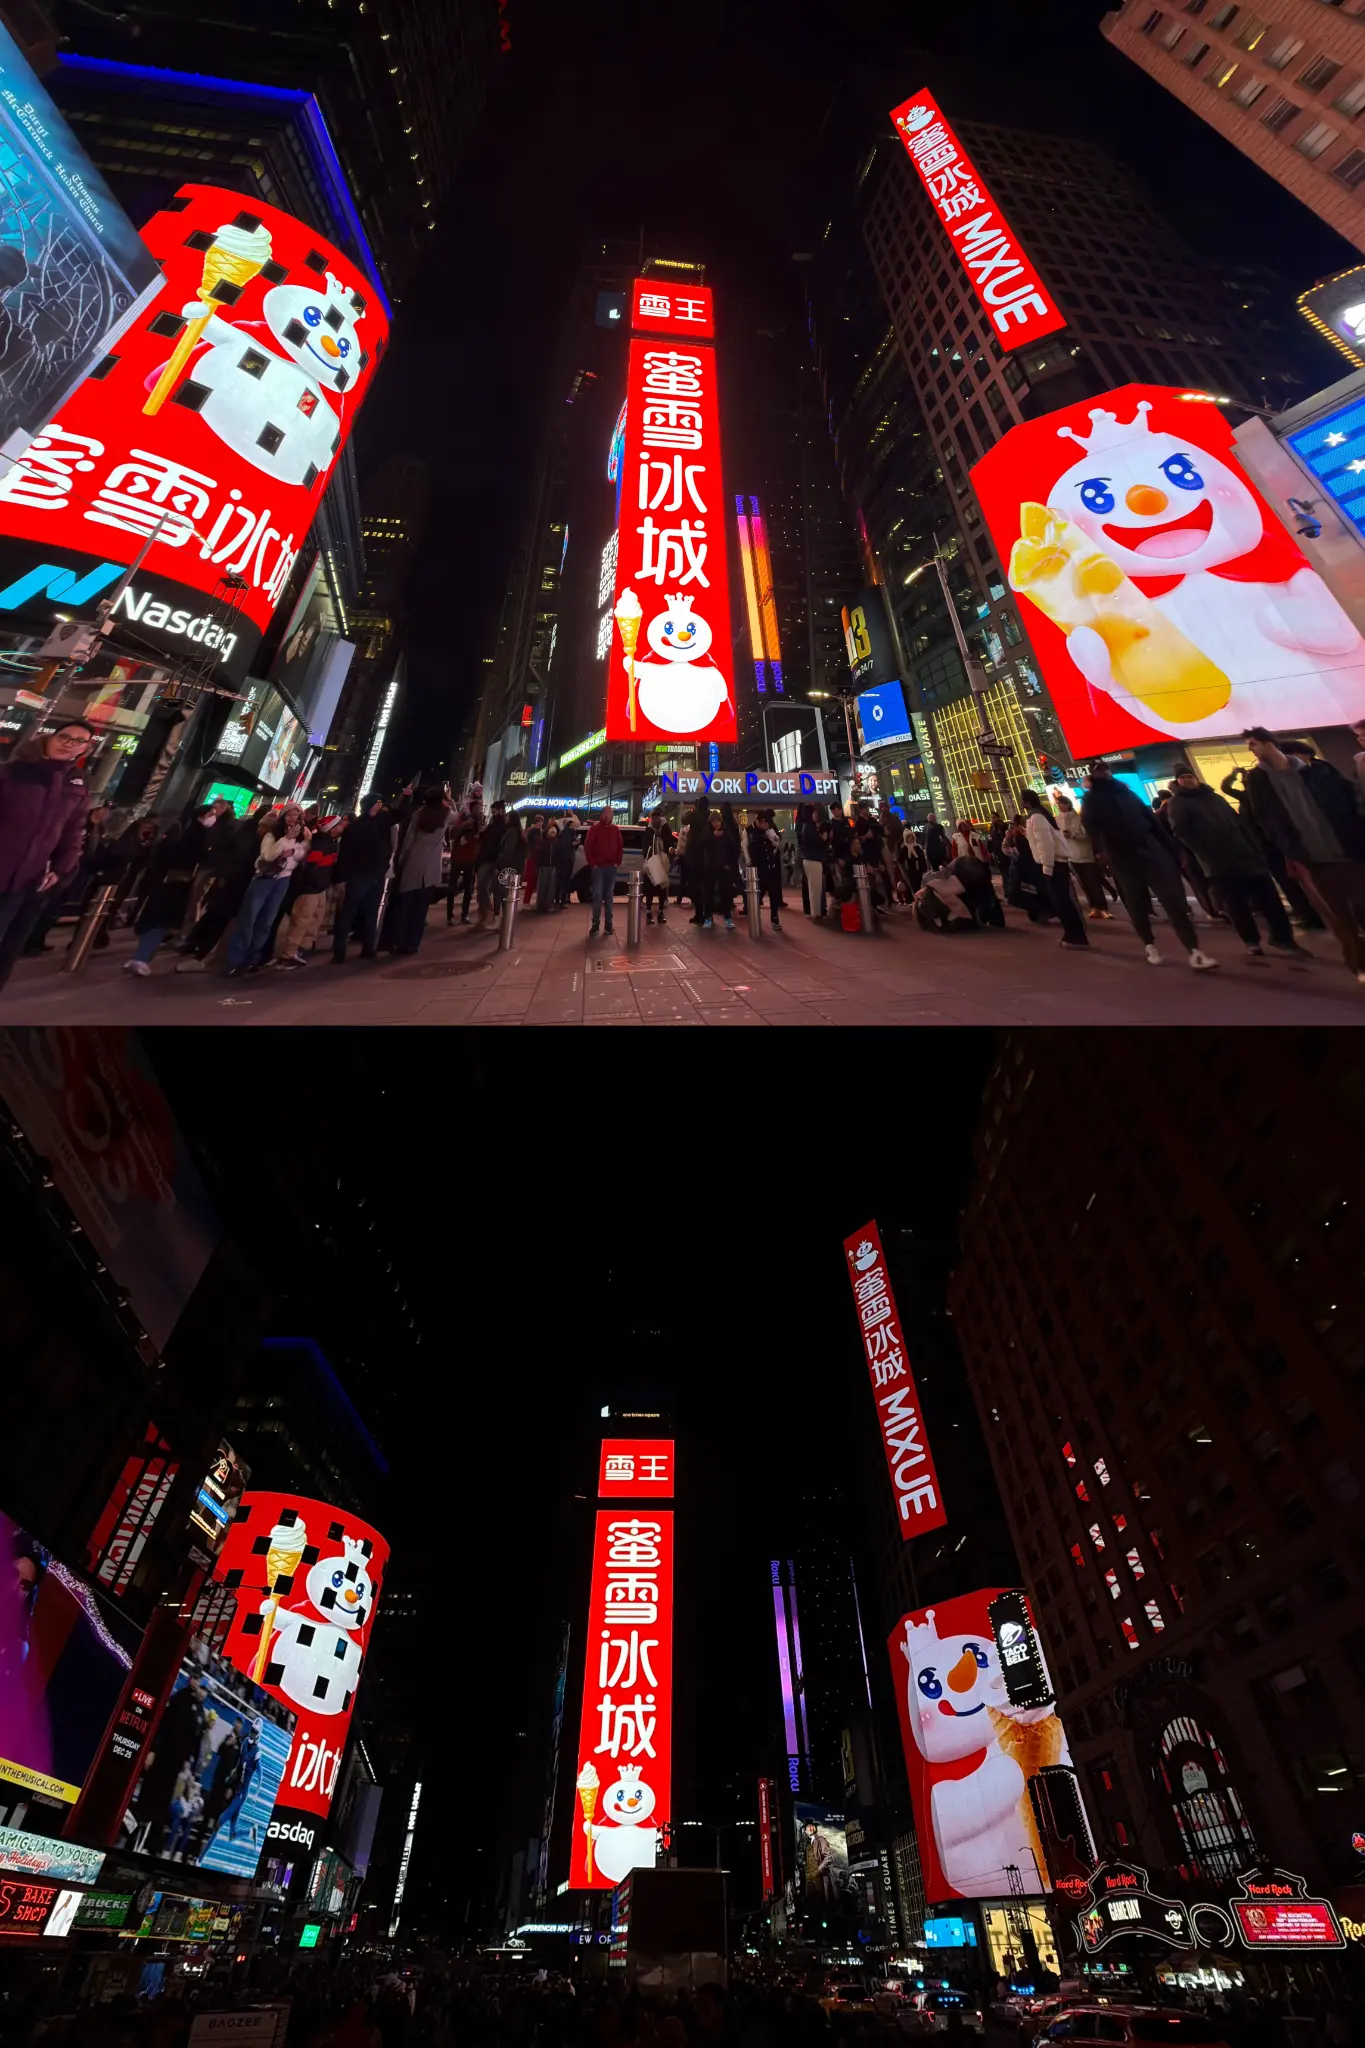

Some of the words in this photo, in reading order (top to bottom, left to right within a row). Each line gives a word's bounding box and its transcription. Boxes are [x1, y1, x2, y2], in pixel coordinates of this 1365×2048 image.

[1, 89, 53, 161] McCormack
[24, 102, 50, 138] Daryl
[54, 162, 80, 198] Haden
[79, 198, 105, 234] Church
[72, 174, 100, 215] Thomas
[952, 211, 1048, 333] MIXUE
[639, 293, 707, 323] 雪王
[112, 587, 239, 662] Nasdaq
[920, 720, 935, 765] SQUARE
[662, 771, 699, 794] NEW
[701, 771, 743, 794] YORK
[745, 773, 796, 795] POLICE
[799, 773, 839, 795] DEPT
[931, 776, 948, 813] TIMES
[909, 793, 931, 802] CHASE
[879, 1386, 937, 1521] MIXUE
[605, 1454, 669, 1481] 雪王
[1002, 1643, 1027, 1658] TACO
[1006, 1652, 1030, 1667] BELL
[135, 1706, 143, 1715] ON
[138, 1693, 152, 1707] LIVE
[119, 1710, 149, 1735] NETFLIX
[112, 1732, 141, 1751] THURSDAY
[112, 1745, 125, 1756] DEC
[124, 1750, 133, 1759] 25
[266, 1820, 315, 1851] asdaq
[52, 1843, 64, 1858] TO
[68, 1847, 98, 1866] YOURS
[880, 1849, 892, 1891] SQUARE
[22, 1887, 54, 1905] BAKE
[1055, 1879, 1074, 1889] Hard
[1075, 1879, 1088, 1888] Roc
[1248, 1884, 1271, 1894] Hard
[1271, 1884, 1293, 1896] Rock
[13, 1904, 47, 1921] SHOP
[887, 1902, 898, 1935] TIMES
